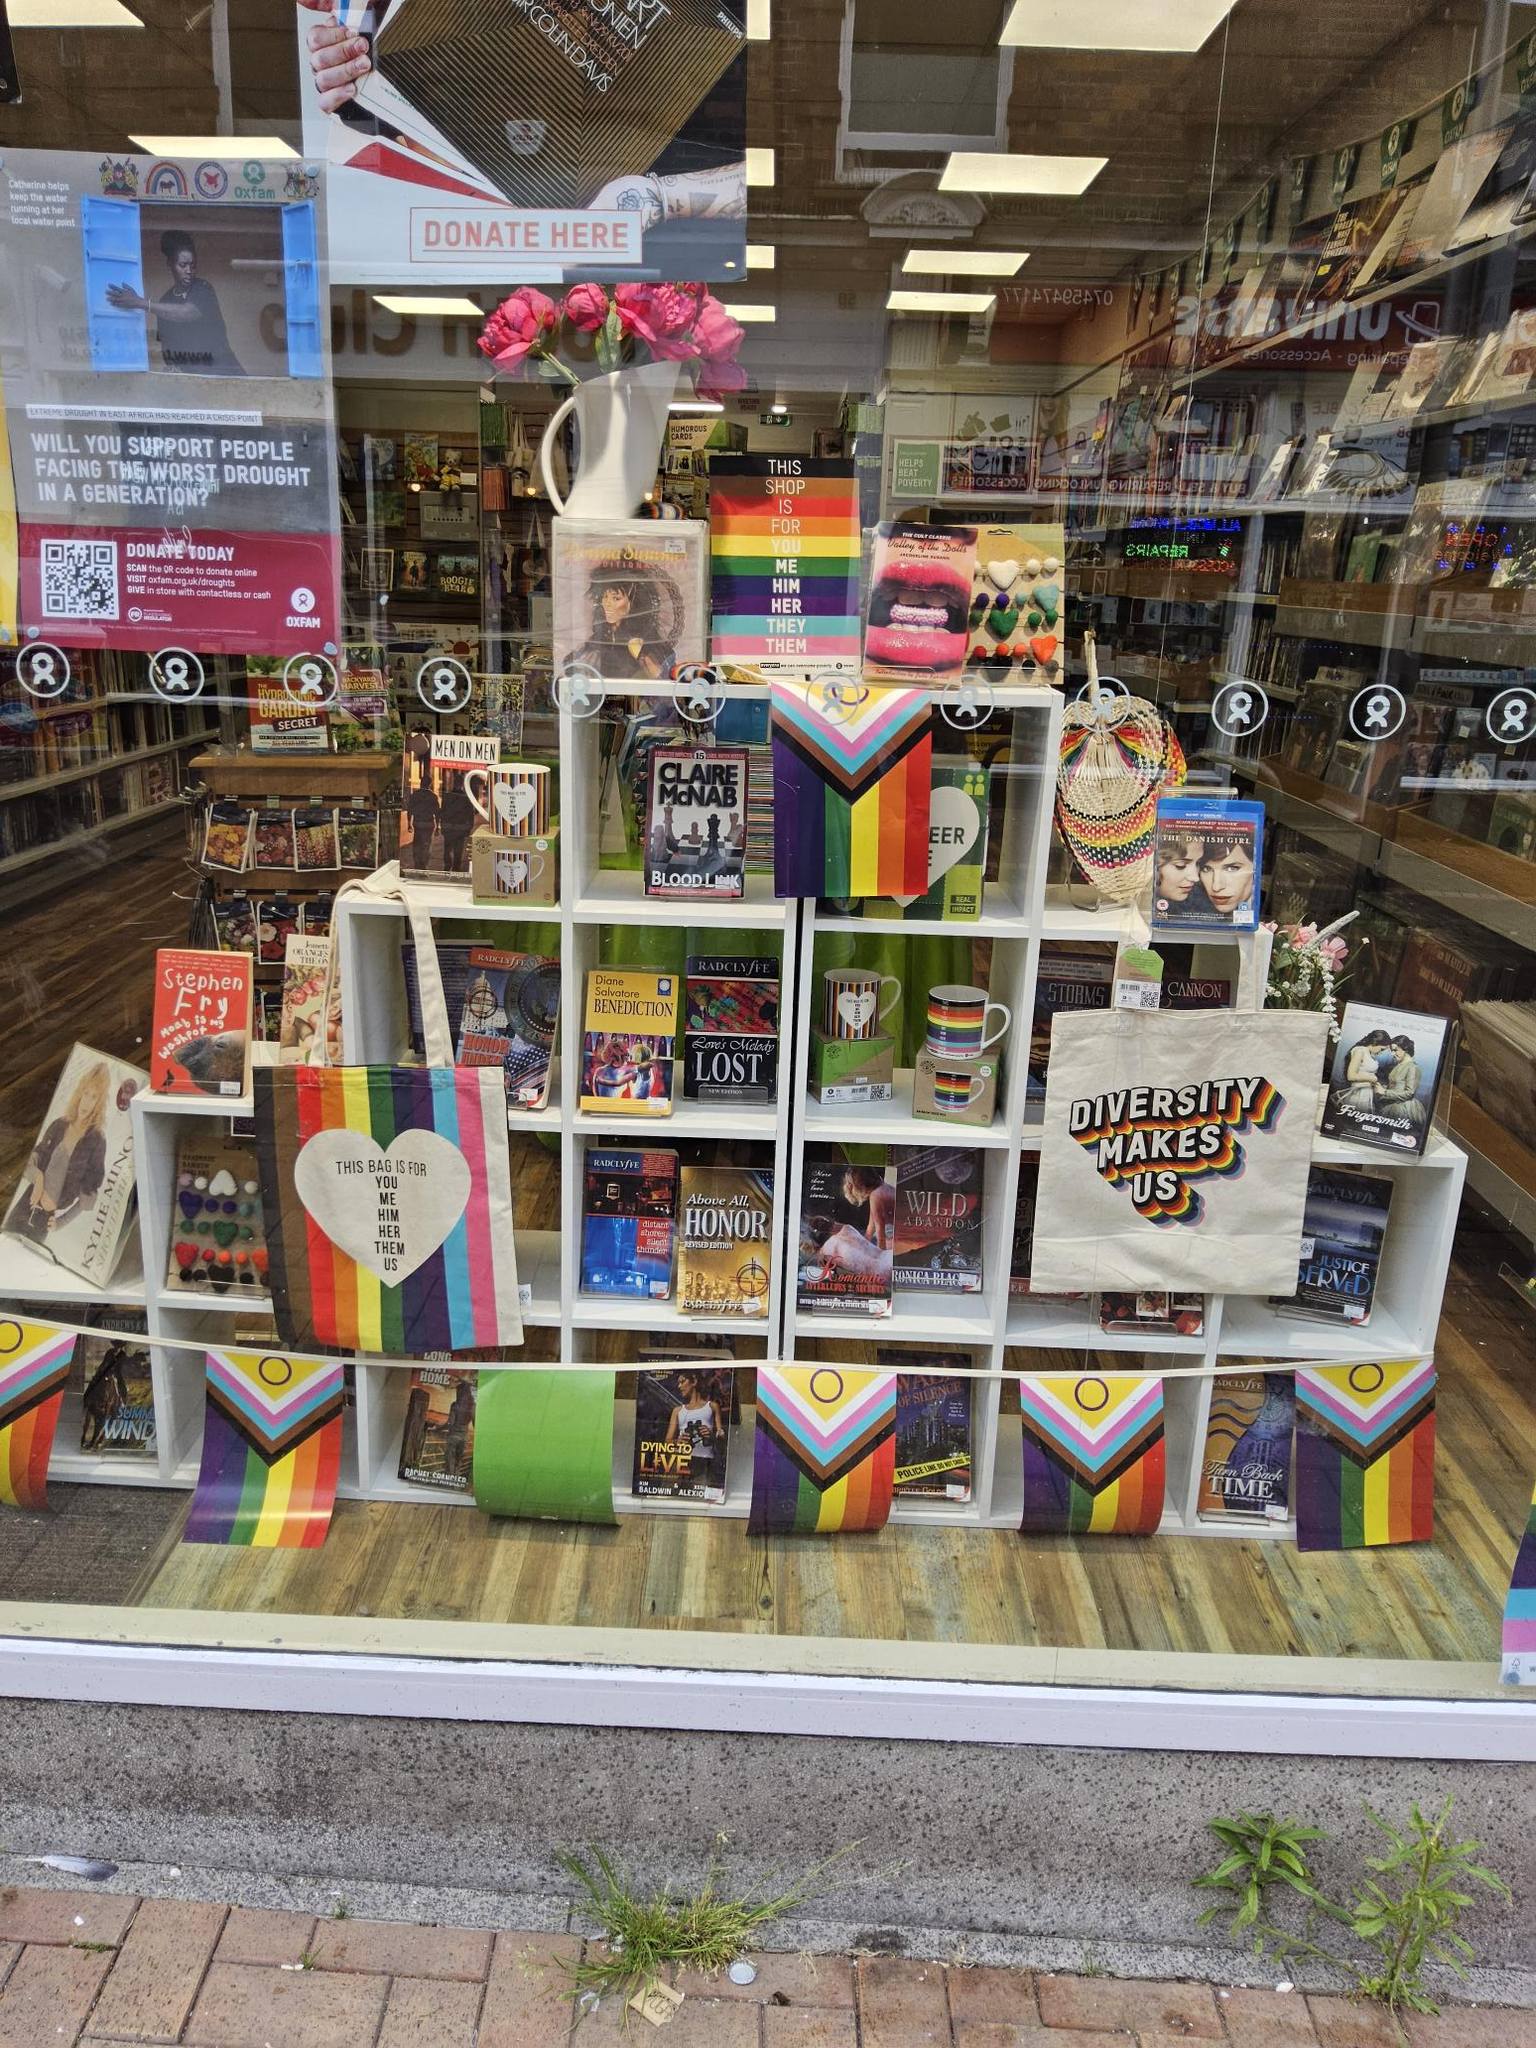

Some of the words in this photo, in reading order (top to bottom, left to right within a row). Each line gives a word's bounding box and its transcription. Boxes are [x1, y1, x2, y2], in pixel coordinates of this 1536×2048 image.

[716, 11, 744, 39] PHILIPS
[530, 5, 570, 55] COLIN
[569, 47, 614, 93] DAVIS
[9, 179, 46, 190] Catherine
[47, 181, 70, 193] helps
[234, 187, 276, 199] Oxfam
[9, 192, 29, 203] keep
[30, 193, 43, 202] the
[45, 193, 68, 203] water
[11, 205, 41, 216] running
[12, 216, 31, 225] local
[32, 218, 54, 226] water
[55, 218, 75, 228] point
[424, 220, 541, 248] DONATE
[551, 222, 629, 250] HERE
[30, 408, 63, 417] EXTREME
[63, 409, 97, 418] DROUGHT
[98, 410, 106, 418] IN
[107, 411, 126, 419] EAST
[128, 411, 153, 420] AFRICA
[171, 412, 205, 421] REACHED
[212, 413, 236, 422] CRISIS
[237, 414, 258, 423] POINT
[671, 425, 707, 433] HUMOROUS
[31, 433, 80, 454] WILL
[84, 435, 121, 455] YOU
[128, 436, 214, 459] SUPPORT
[221, 439, 294, 462] PEOPLE
[768, 459, 802, 475] THIS
[899, 458, 924, 467] HELPS
[35, 458, 102, 479] FACING
[107, 460, 144, 481] THE
[149, 462, 217, 484] WORST
[224, 464, 311, 486] DROUGHT
[898, 468, 918, 476] BEAT
[765, 479, 806, 495] SHOP
[897, 478, 932, 487] POVERTY
[38, 482, 57, 501] IN
[63, 484, 78, 502] A
[83, 484, 209, 506] GENERATION?
[779, 499, 793, 514] IS
[771, 518, 801, 534] FOR
[126, 543, 184, 560] DONATE
[189, 546, 235, 562] TODAY
[771, 538, 801, 554] YOU
[887, 538, 916, 552] Valley
[918, 542, 927, 553] of
[927, 542, 940, 552] the
[941, 543, 968, 554] Dolls
[126, 563, 147, 573] SCAN
[149, 565, 162, 573] the
[163, 565, 174, 574] QR
[175, 566, 194, 575] code
[196, 567, 205, 575] to
[206, 567, 233, 577] donate
[234, 569, 258, 577] online
[775, 558, 798, 574] ME
[127, 575, 146, 583] VISIT
[148, 576, 236, 588] oxfam.org.uk/droughts
[440, 576, 475, 585] BOOGIE
[772, 578, 801, 594] HIM
[127, 586, 145, 594] GIVE
[147, 587, 155, 595] in
[156, 587, 177, 596] store
[178, 588, 195, 597] with
[196, 589, 242, 599] contactless
[253, 591, 272, 600] cash
[771, 598, 802, 614] HER
[286, 617, 321, 629] OXFAM
[766, 617, 806, 634] THEY
[766, 637, 807, 654] THEM
[259, 702, 317, 718] GARDEN
[277, 717, 319, 731] SECRET
[434, 739, 456, 758] MEN
[459, 741, 469, 758] ON
[475, 742, 496, 761] MEN
[695, 752, 705, 760] 15
[659, 762, 739, 786] CLAIRE
[659, 784, 738, 807] McNAB
[1186, 835, 1225, 844] DANISH
[1227, 837, 1252, 845] GIRL
[651, 870, 703, 888] BLOOD
[951, 905, 975, 913] IMPACT
[292, 948, 329, 957] ORANGES
[162, 967, 243, 992] Stephen
[595, 975, 624, 986] Diane
[595, 987, 640, 999] Salvatore
[1048, 983, 1105, 1006] STORMS
[1167, 982, 1222, 998] CANNON
[173, 986, 229, 1020] Fry
[594, 998, 674, 1017] BENEDICTION
[194, 1014, 207, 1026] is
[691, 1036, 725, 1051] Love's
[730, 1039, 775, 1056] Melody
[695, 1051, 763, 1083] LOST
[1068, 1076, 1263, 1133] DIVERSITY
[1336, 1103, 1413, 1131] Fingersmith
[1097, 1124, 1222, 1170] MAKES
[336, 1160, 364, 1175] THIS
[368, 1159, 392, 1173] BAG
[396, 1160, 406, 1174] IS
[408, 1161, 427, 1177] FOR
[375, 1176, 398, 1189] YOU
[1131, 1170, 1180, 1206] US
[379, 1192, 396, 1206] ME
[687, 1194, 726, 1207] Above
[728, 1195, 750, 1209] All,
[905, 1190, 968, 1217] WILD
[378, 1208, 400, 1222] HIM
[378, 1224, 401, 1238] HER
[642, 1221, 669, 1230] distant
[684, 1207, 768, 1240] HONOR
[904, 1217, 977, 1230] ABANDON
[81, 1203, 111, 1270] KYLIE
[640, 1229, 669, 1238] shores,
[374, 1241, 405, 1256] THEM
[646, 1238, 668, 1246] silent
[684, 1241, 709, 1249] REVISED
[709, 1242, 734, 1250] EDITION
[636, 1246, 668, 1255] thunder
[384, 1257, 398, 1271] US
[806, 1256, 886, 1284] Romantic
[1317, 1255, 1370, 1275] JUSTICE
[424, 1350, 452, 1362] LONG
[420, 1371, 450, 1385] HOME
[897, 1396, 910, 1409] OF
[913, 1382, 962, 1405] SILENCE
[641, 1441, 675, 1454] DYING
[677, 1443, 692, 1454] TO
[640, 1452, 692, 1475] LIVE
[897, 1465, 924, 1480] POLICE
[924, 1462, 938, 1475] LINE
[1203, 1459, 1239, 1478] Turn
[1241, 1463, 1283, 1482] Back
[638, 1486, 672, 1496] BALDWIN
[1207, 1476, 1274, 1499] TIME
